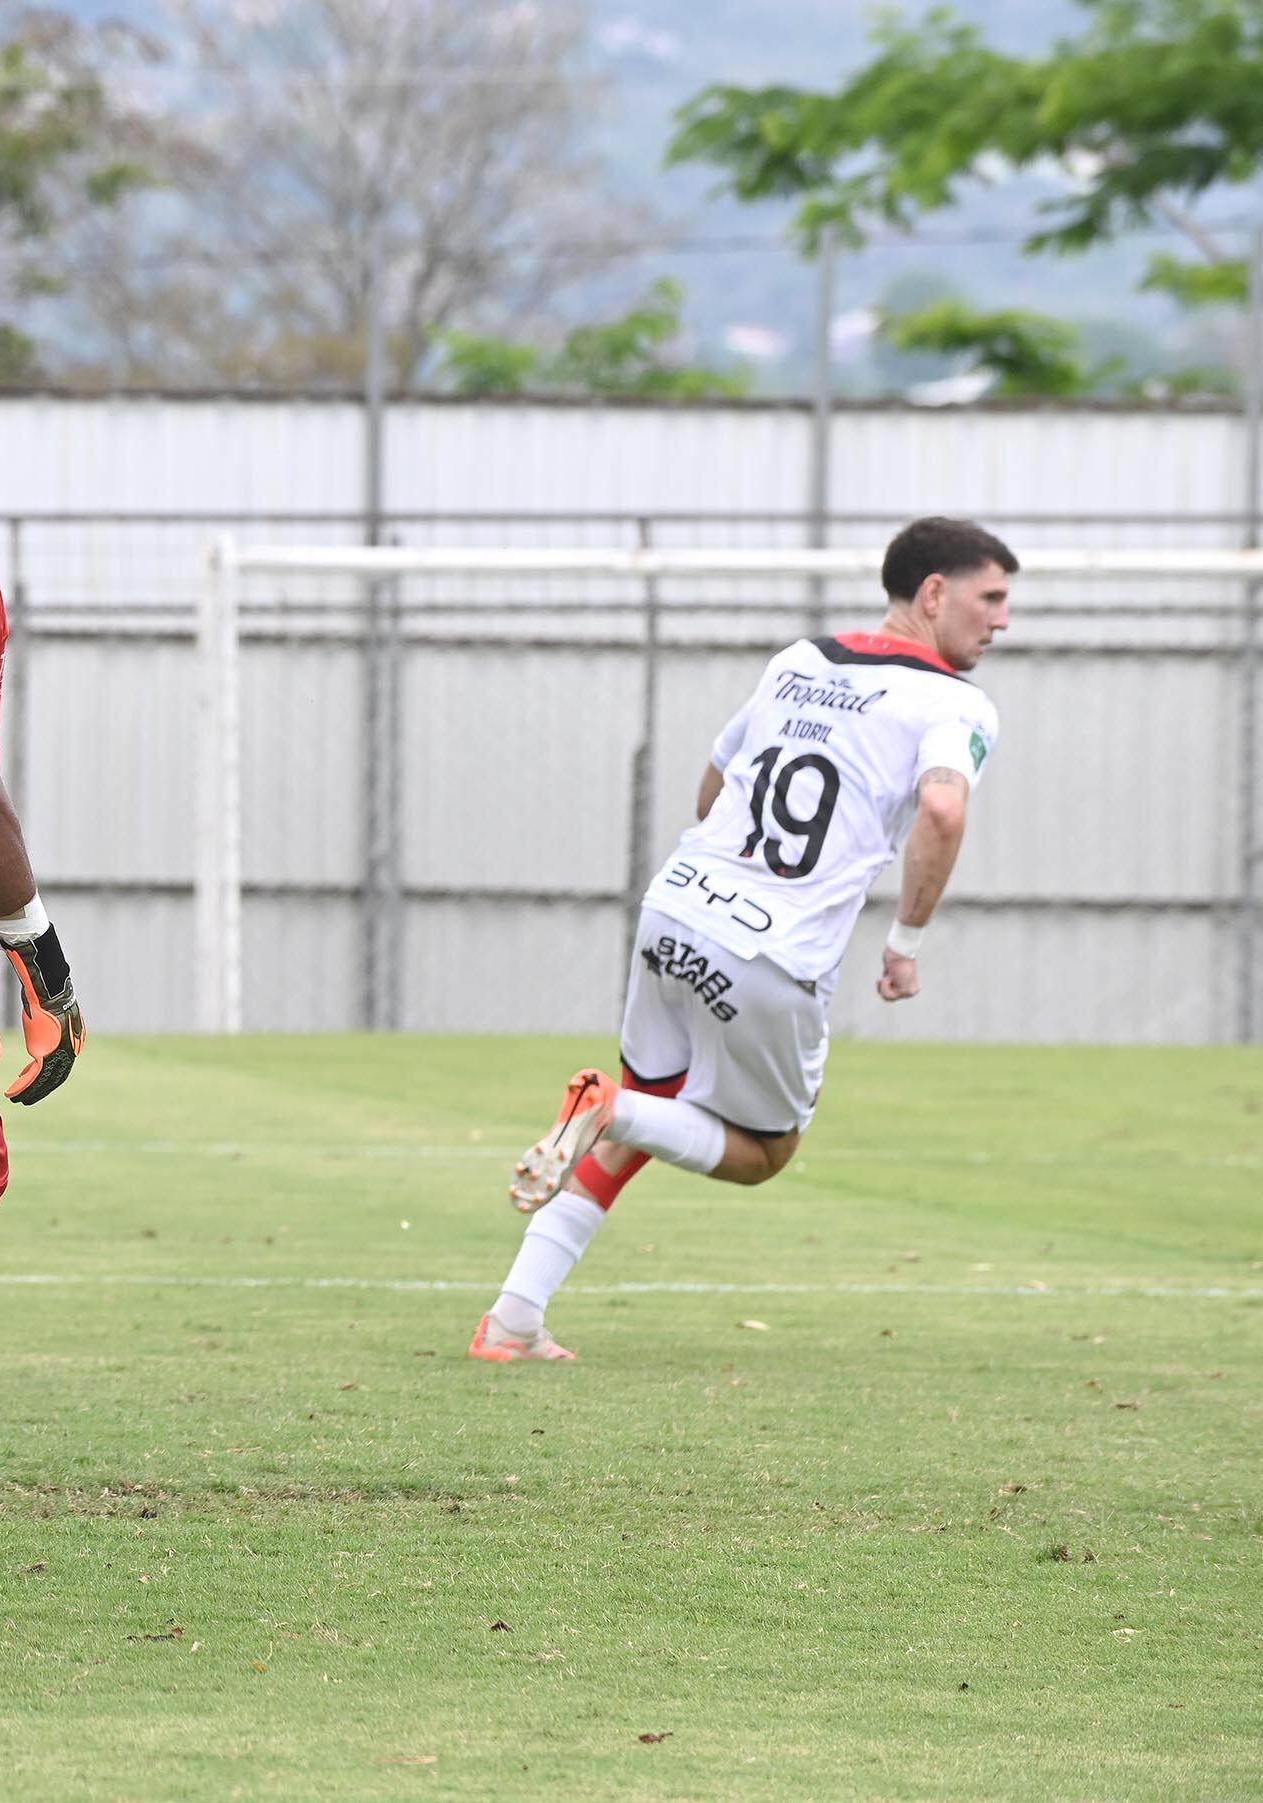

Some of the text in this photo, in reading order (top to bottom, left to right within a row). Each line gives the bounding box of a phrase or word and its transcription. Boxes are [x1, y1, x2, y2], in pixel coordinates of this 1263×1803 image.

[774, 670, 888, 715] Tropical
[738, 746, 841, 879] 19
[665, 861, 772, 933] BYD
[657, 935, 733, 995] STAR
[665, 958, 739, 1022] CARS
